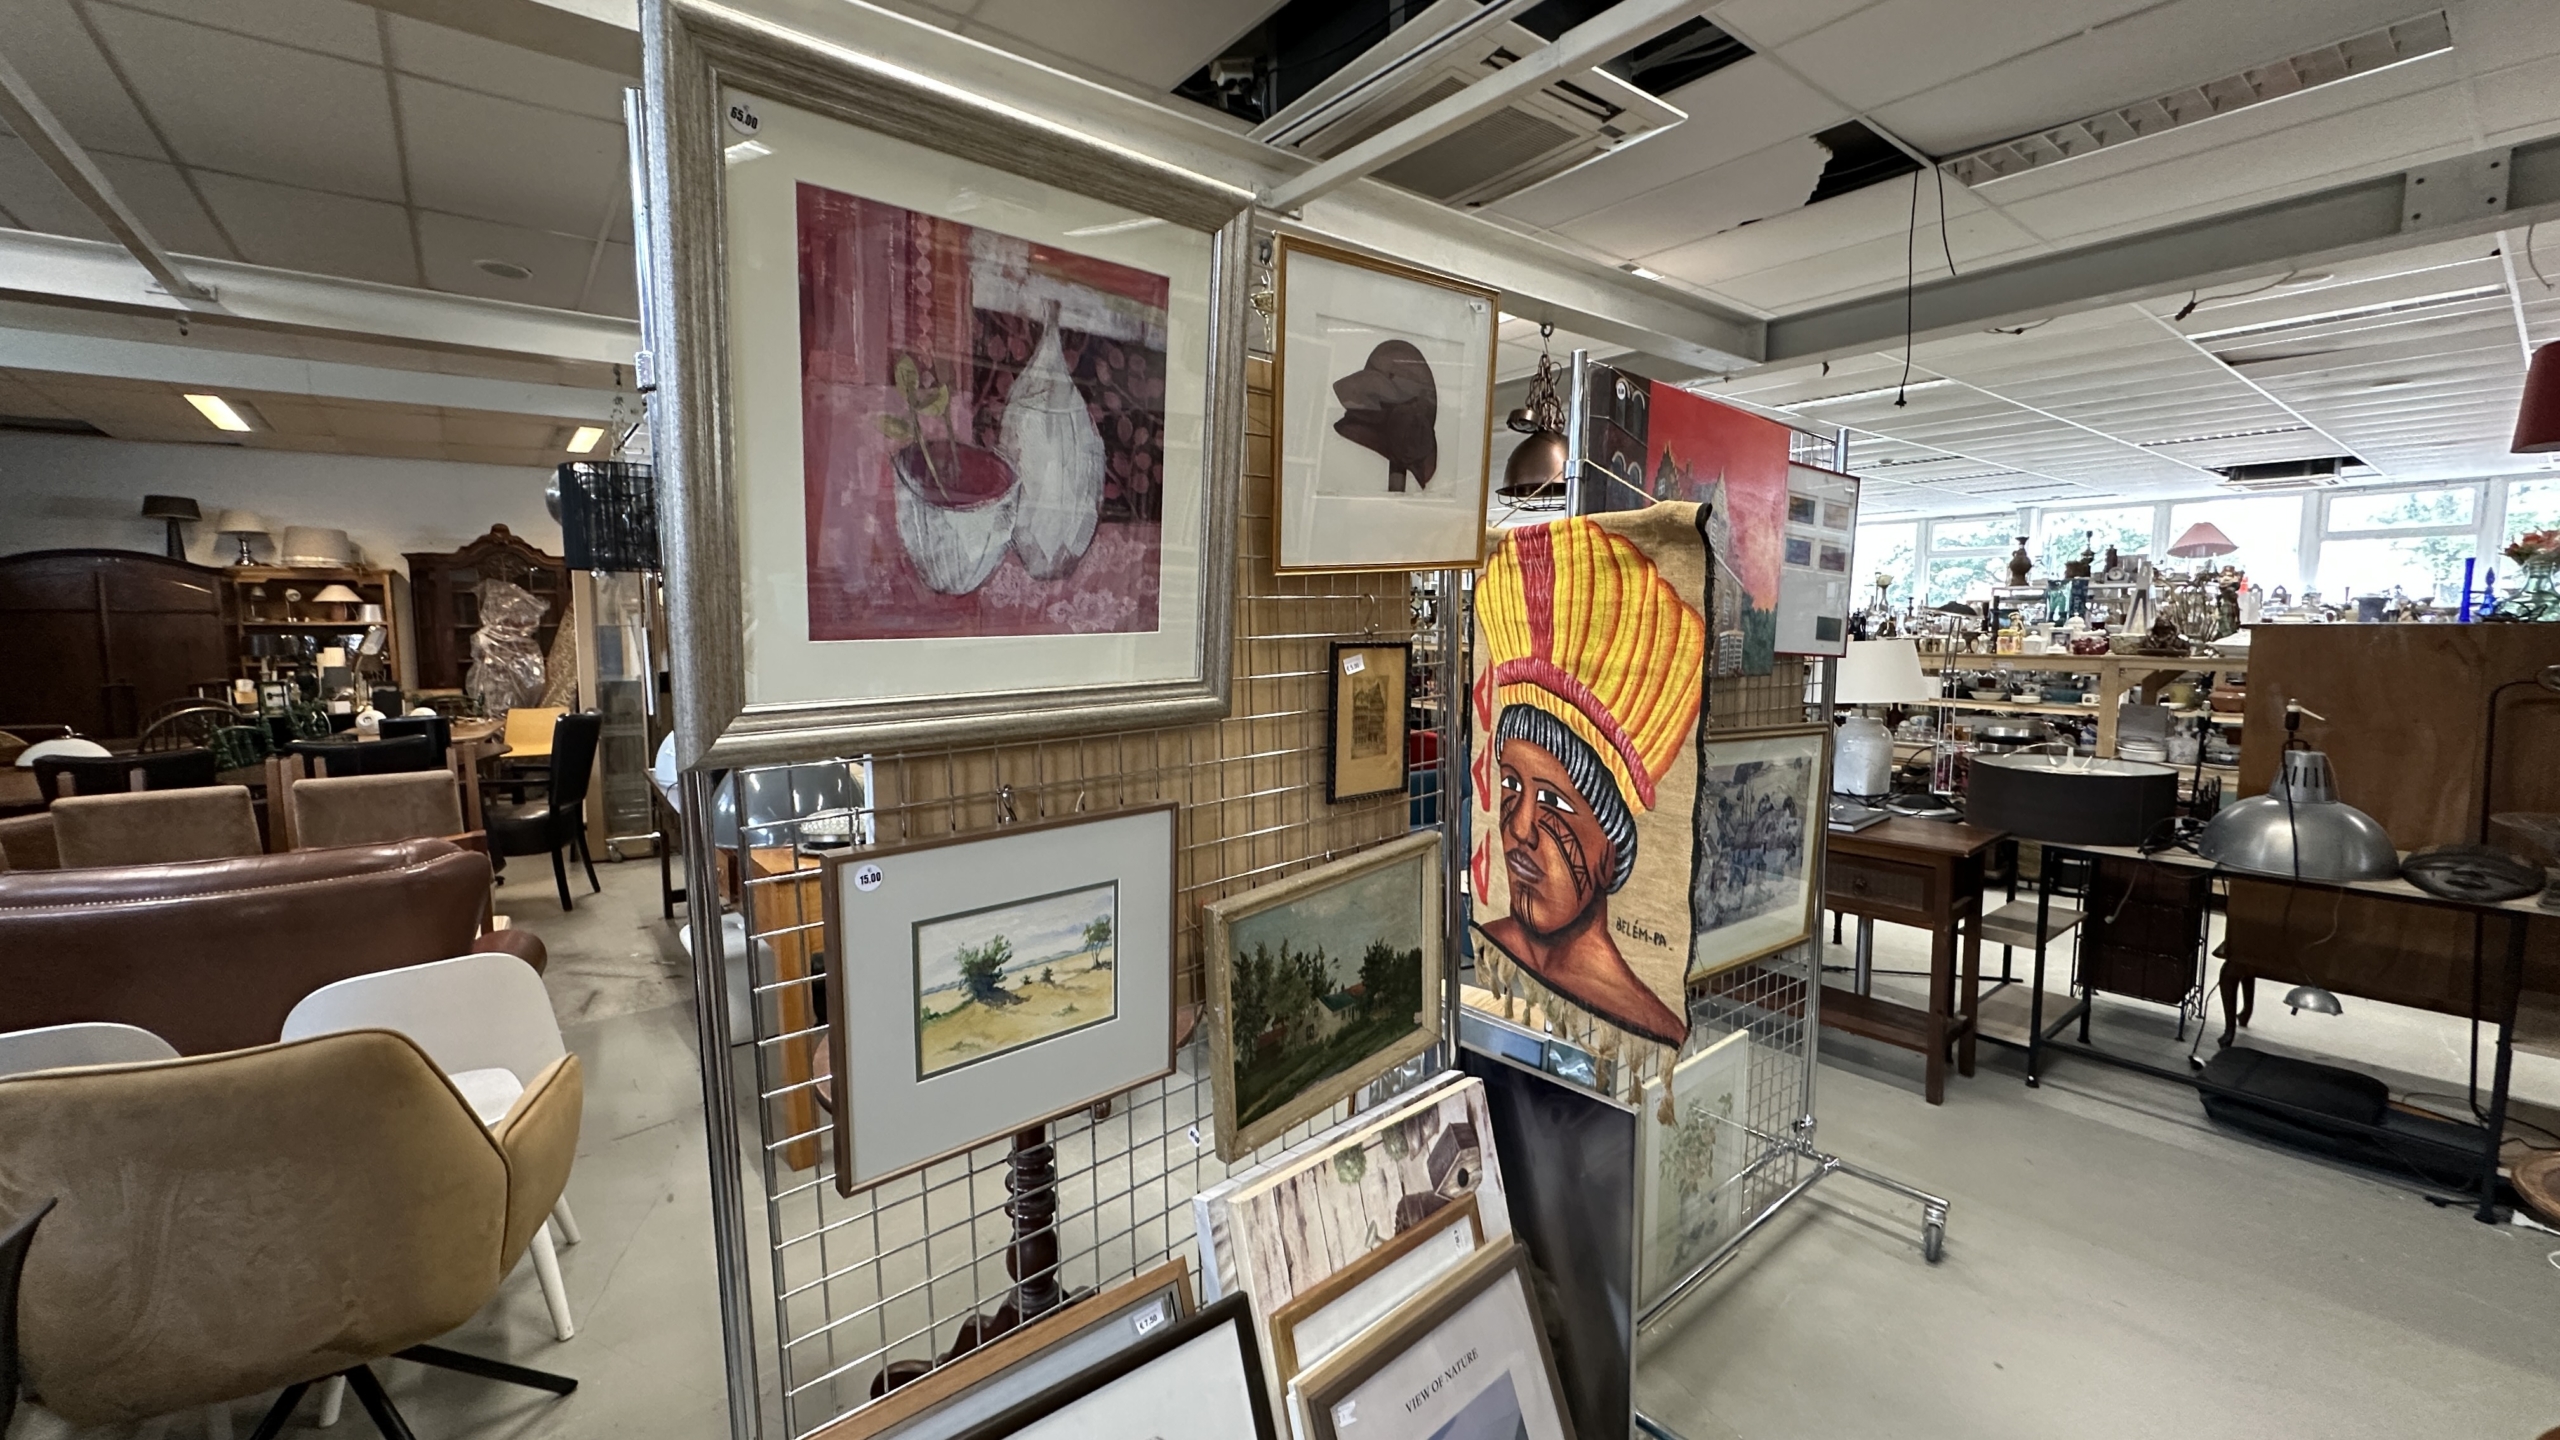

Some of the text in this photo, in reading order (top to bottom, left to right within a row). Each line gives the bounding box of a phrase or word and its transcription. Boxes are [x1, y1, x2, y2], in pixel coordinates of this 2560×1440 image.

[1405, 1347, 1479, 1414] VIEW OF NATURE
